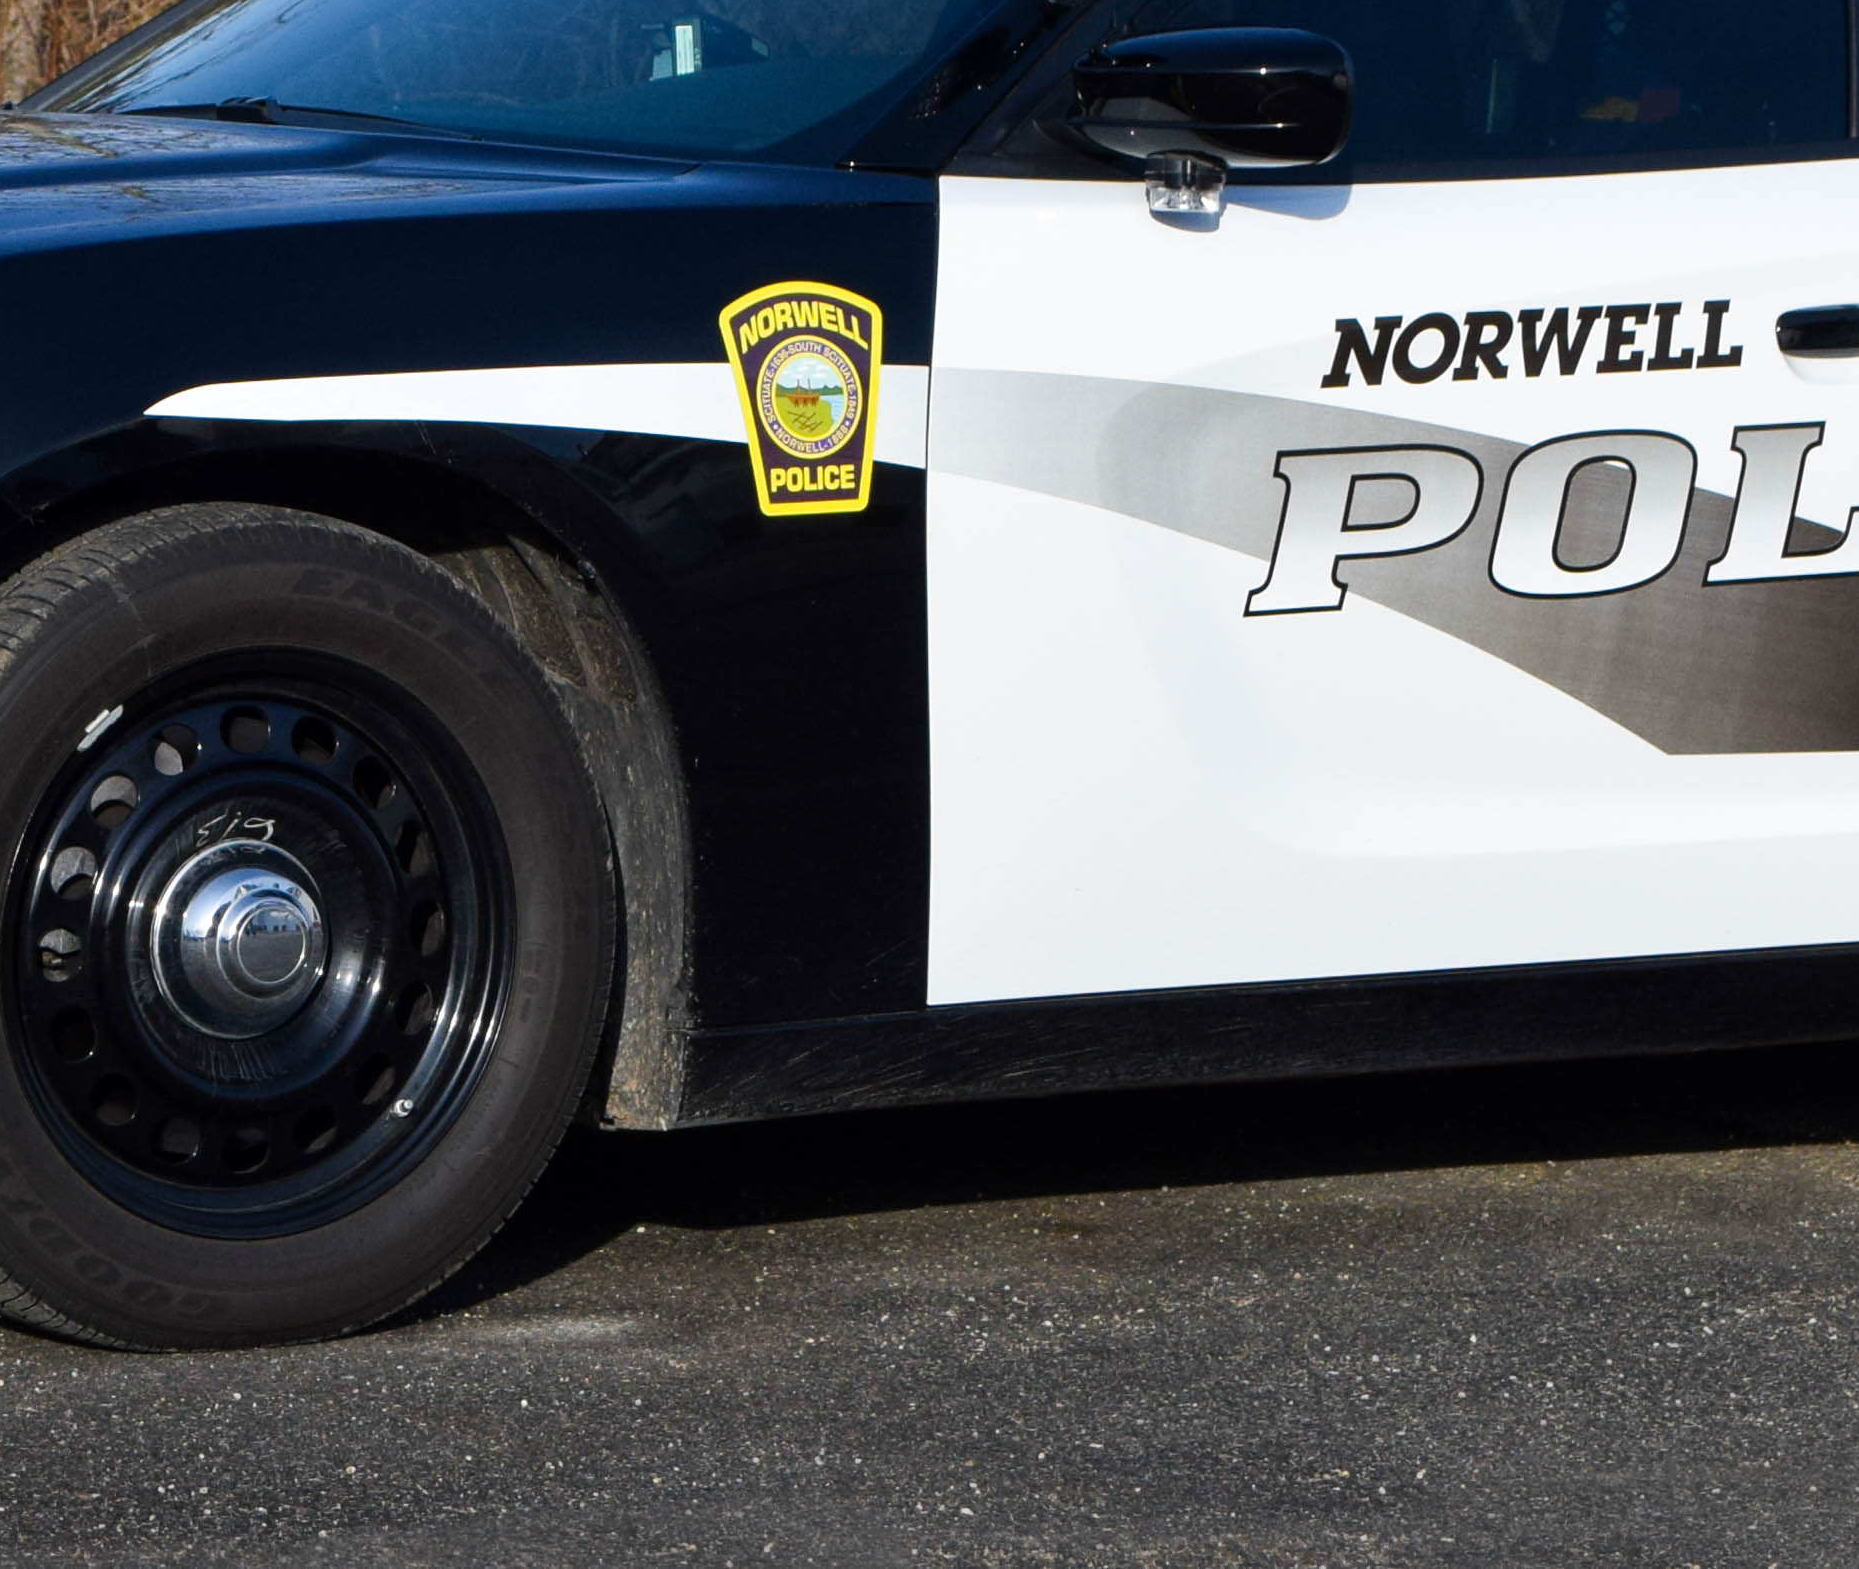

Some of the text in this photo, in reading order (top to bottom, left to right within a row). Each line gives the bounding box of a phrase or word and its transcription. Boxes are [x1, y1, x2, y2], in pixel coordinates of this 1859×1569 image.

[739, 301, 869, 355] NORWELL
[1320, 299, 1743, 388] NORWELL
[770, 464, 856, 493] POLICE
